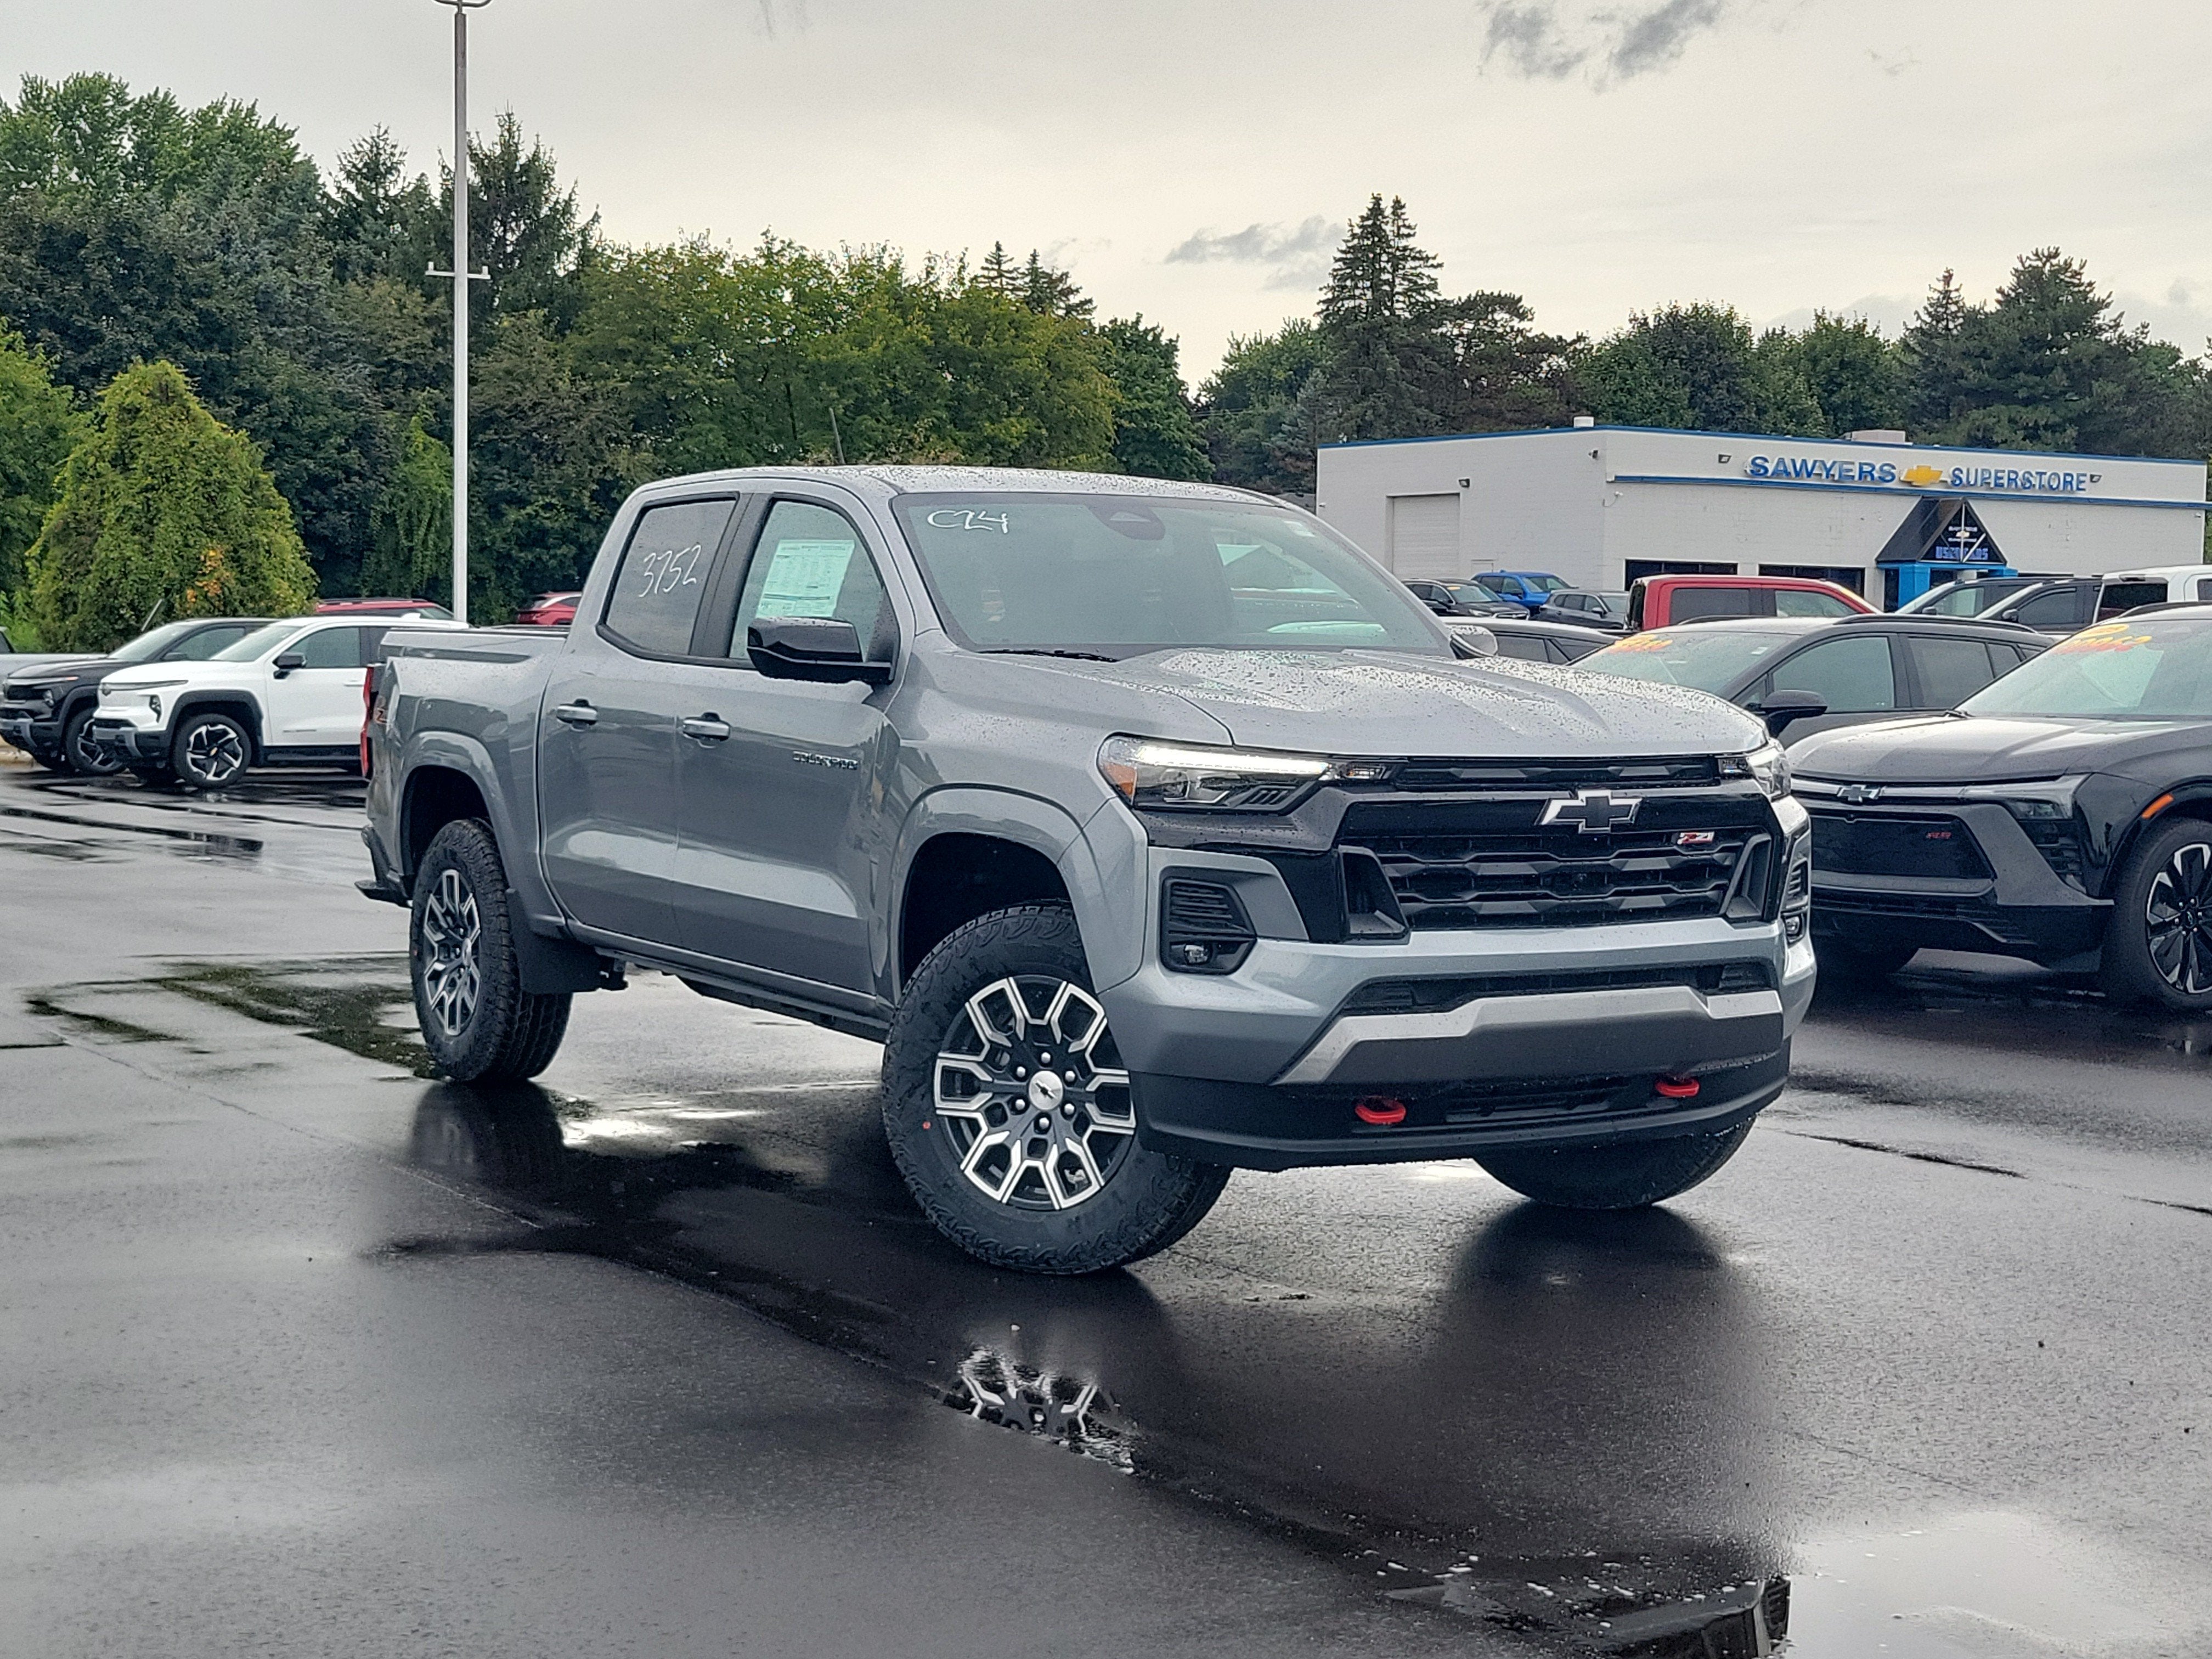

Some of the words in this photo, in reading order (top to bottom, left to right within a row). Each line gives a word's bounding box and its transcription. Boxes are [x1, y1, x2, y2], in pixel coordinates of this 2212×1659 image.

[1748, 455, 1897, 484] SAWYERS
[1950, 466, 2087, 492] SUPERSTORE
[639, 544, 701, 597] 3752
